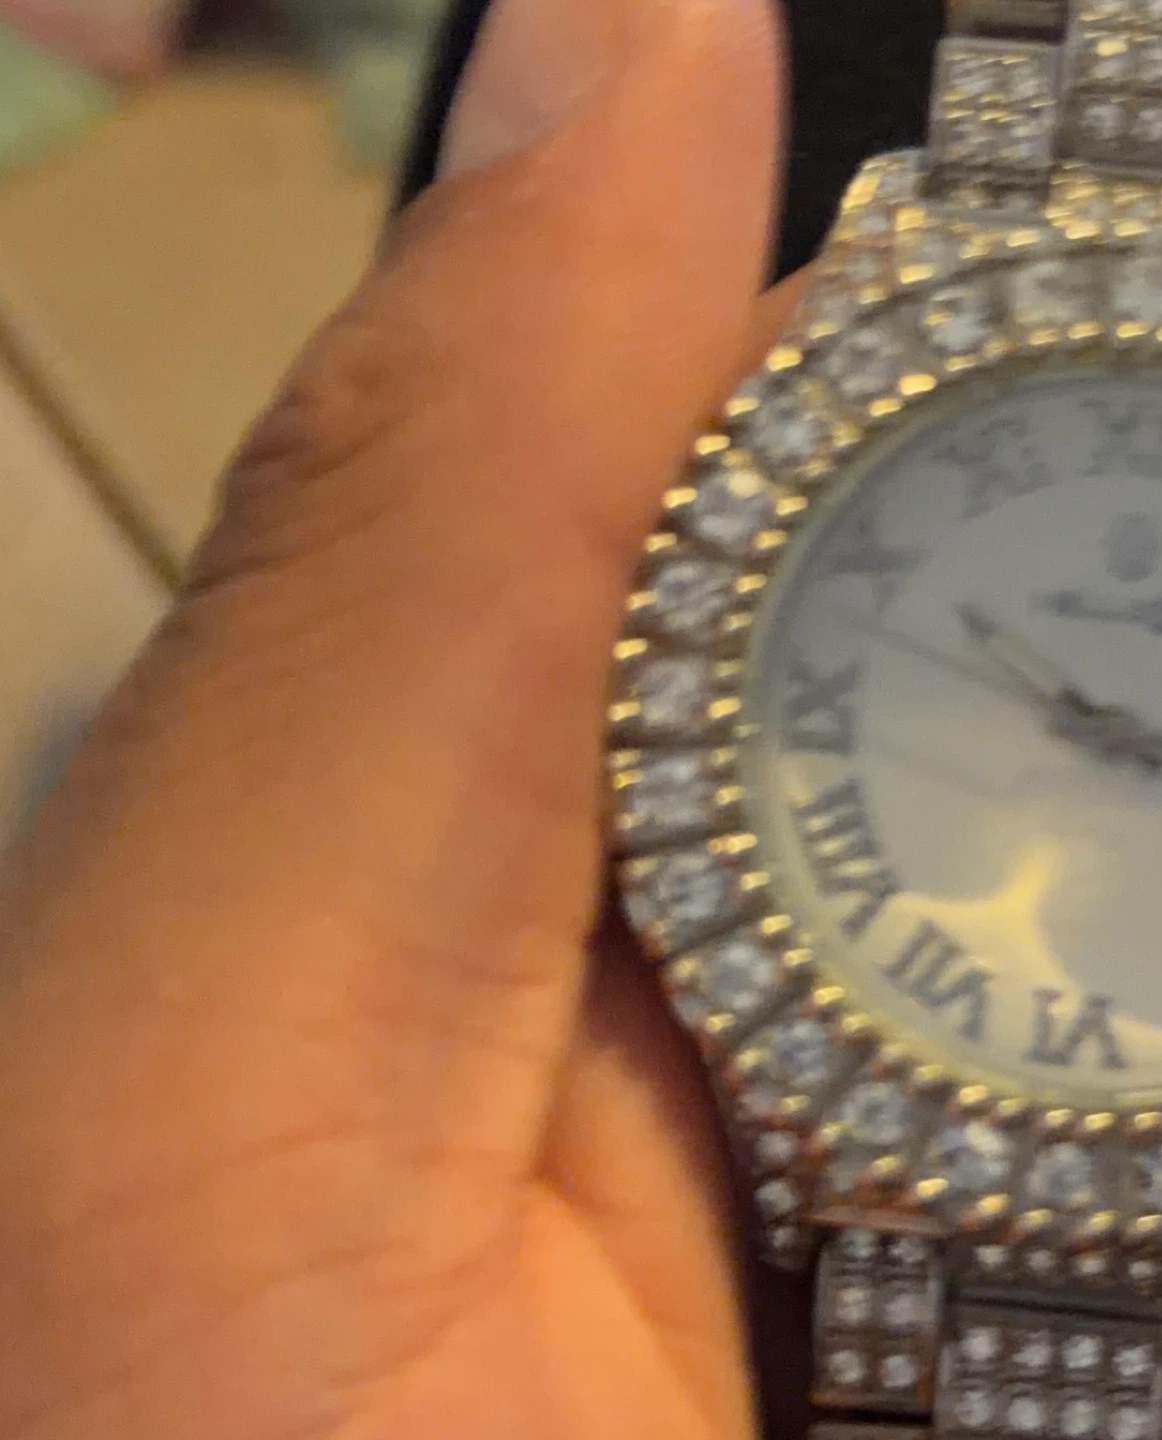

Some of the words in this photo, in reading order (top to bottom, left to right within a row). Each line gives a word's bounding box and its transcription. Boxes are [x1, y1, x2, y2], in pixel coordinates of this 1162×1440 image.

[780, 656, 864, 758] IX
[793, 778, 900, 940] VIII
[882, 918, 996, 1042] VII
[1022, 986, 1130, 1070] VI
